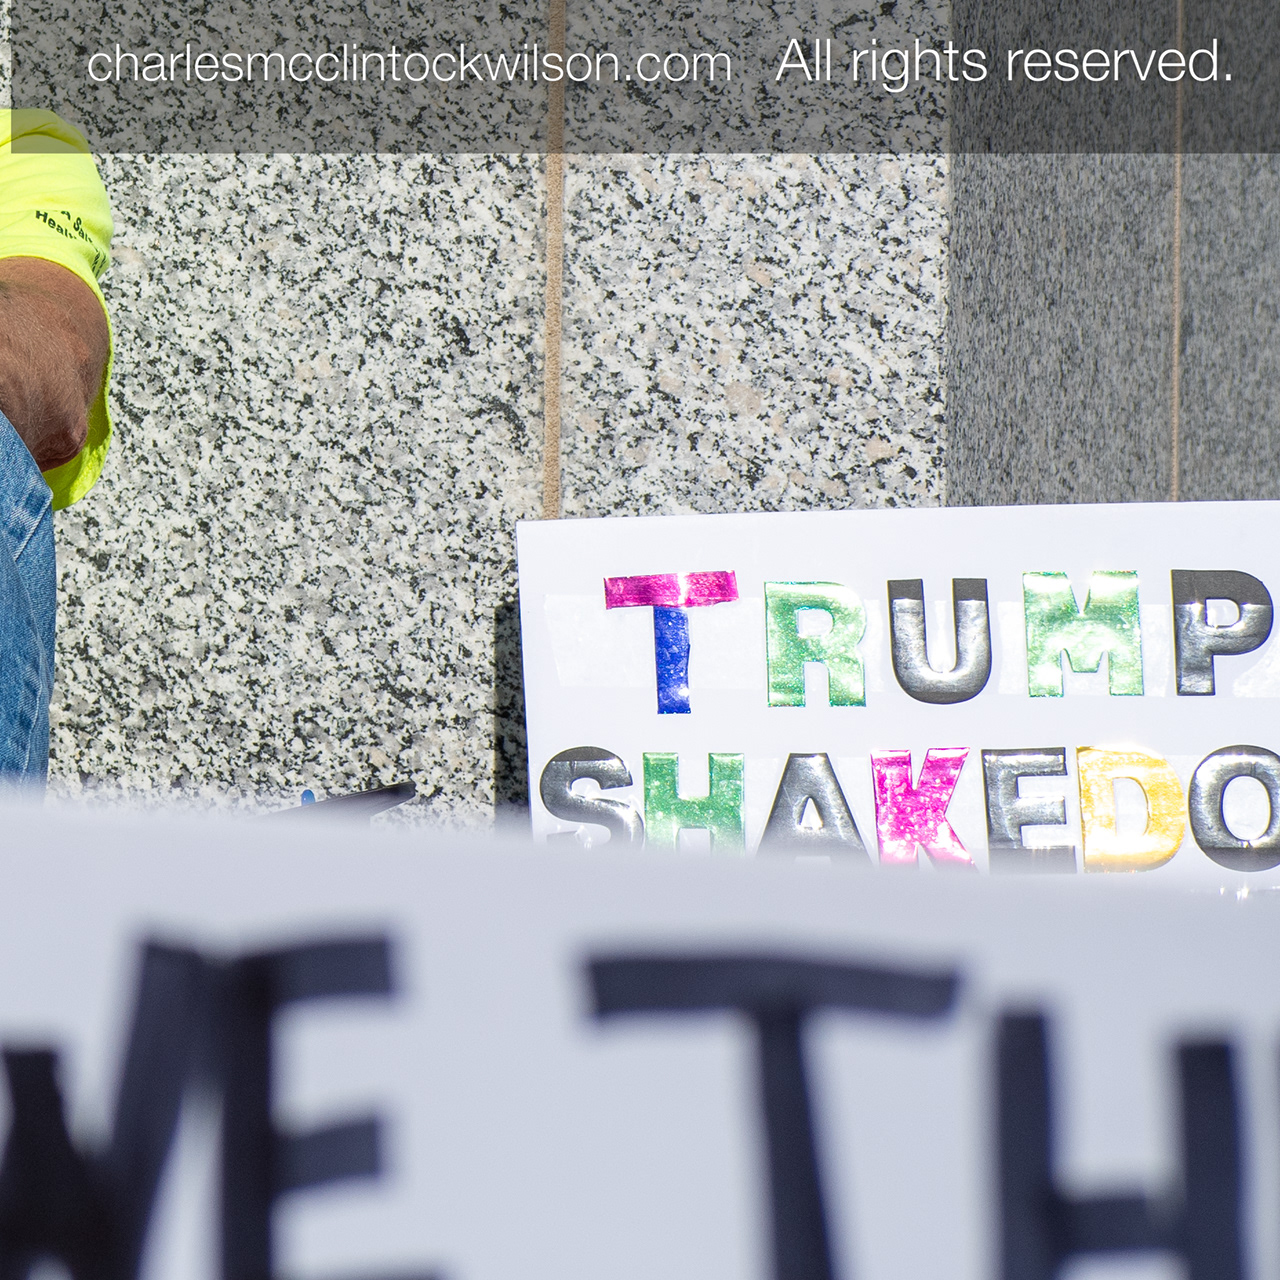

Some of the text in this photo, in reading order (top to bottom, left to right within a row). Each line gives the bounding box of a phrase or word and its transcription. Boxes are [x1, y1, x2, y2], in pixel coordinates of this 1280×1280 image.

[35, 210, 78, 240] Heal
[603, 569, 1275, 714] TRUMP
[539, 743, 1280, 873] SHAKEDO
[578, 940, 1280, 1280] TH
